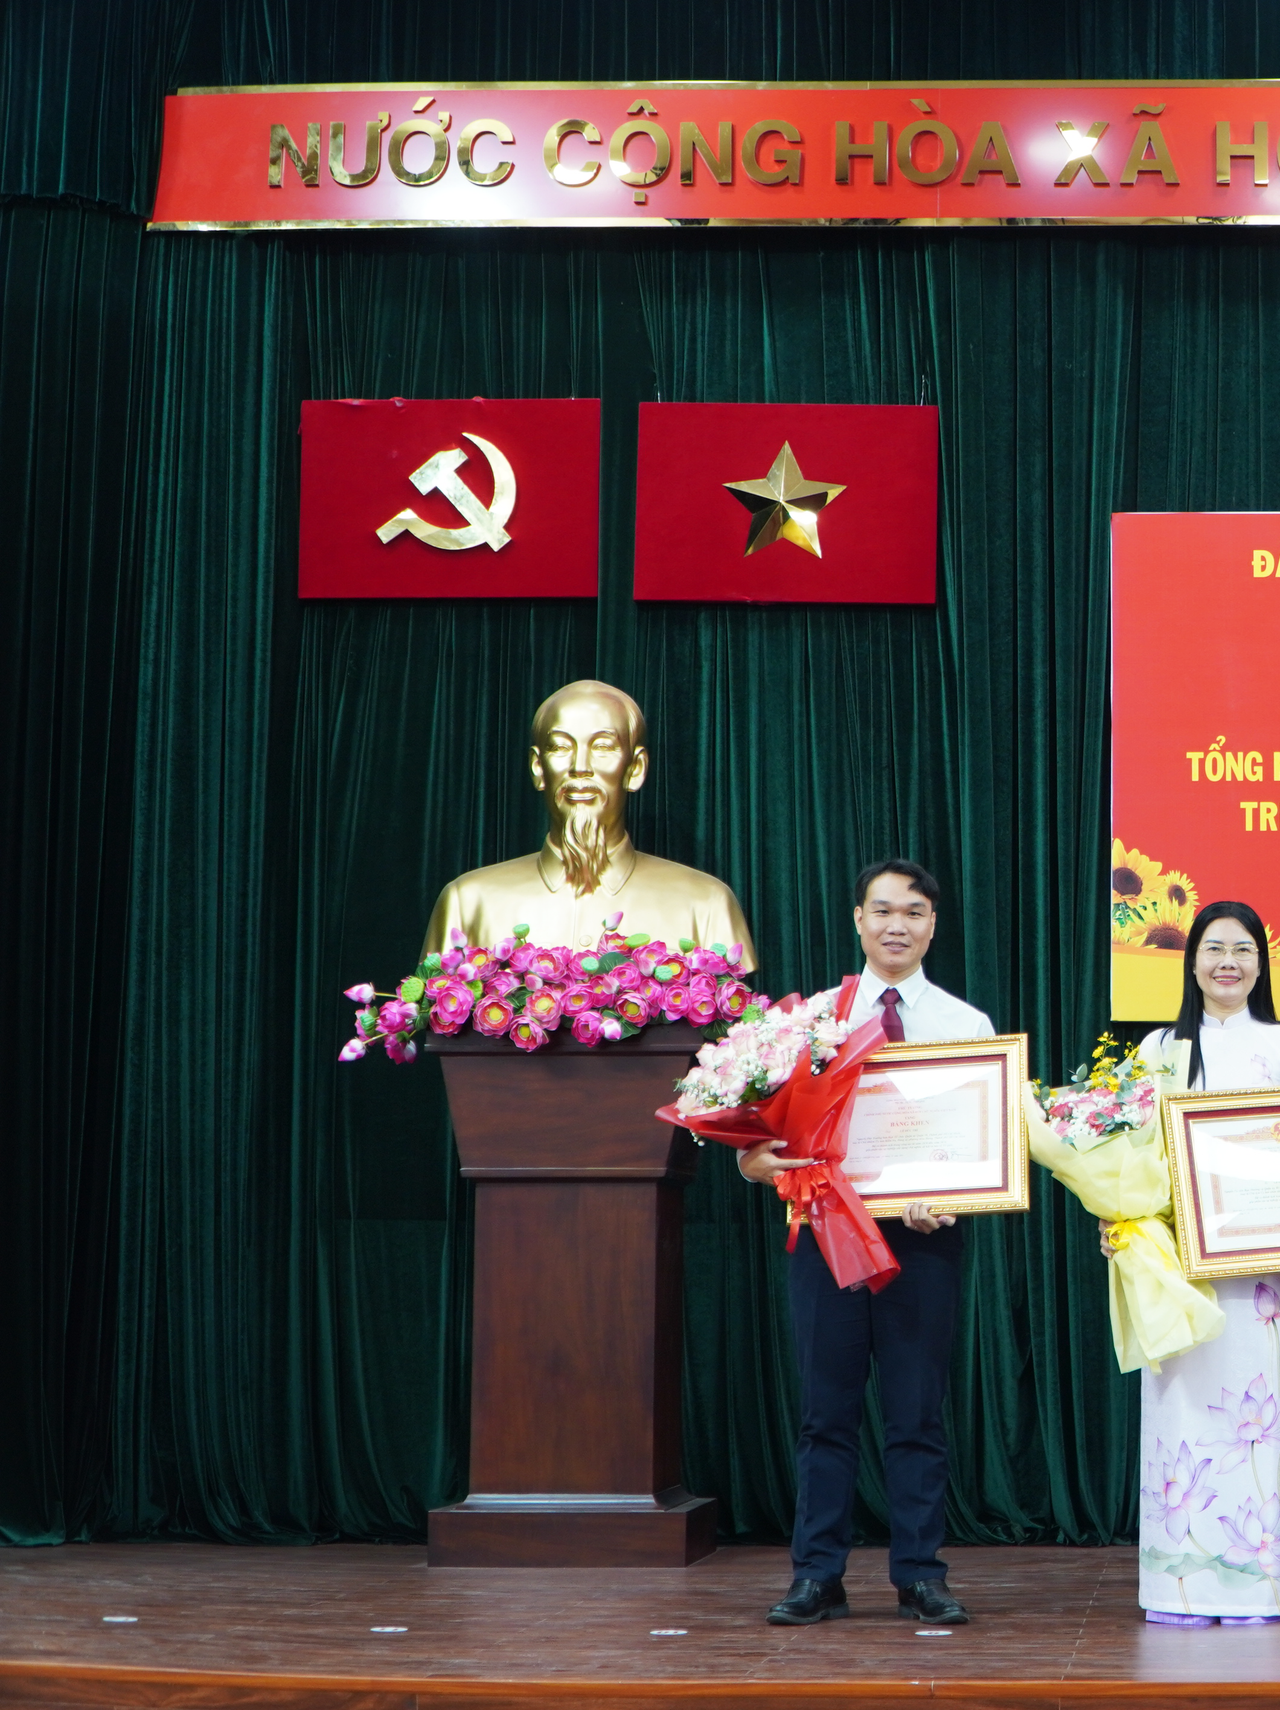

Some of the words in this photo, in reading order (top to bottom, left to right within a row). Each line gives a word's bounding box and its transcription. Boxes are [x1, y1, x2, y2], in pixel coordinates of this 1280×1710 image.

[267, 96, 515, 188] NƯỚC
[542, 99, 804, 204] CỘNG
[834, 98, 1021, 187] HÒA
[1053, 102, 1181, 187] XÃ
[1186, 735, 1264, 782] TỔNG
